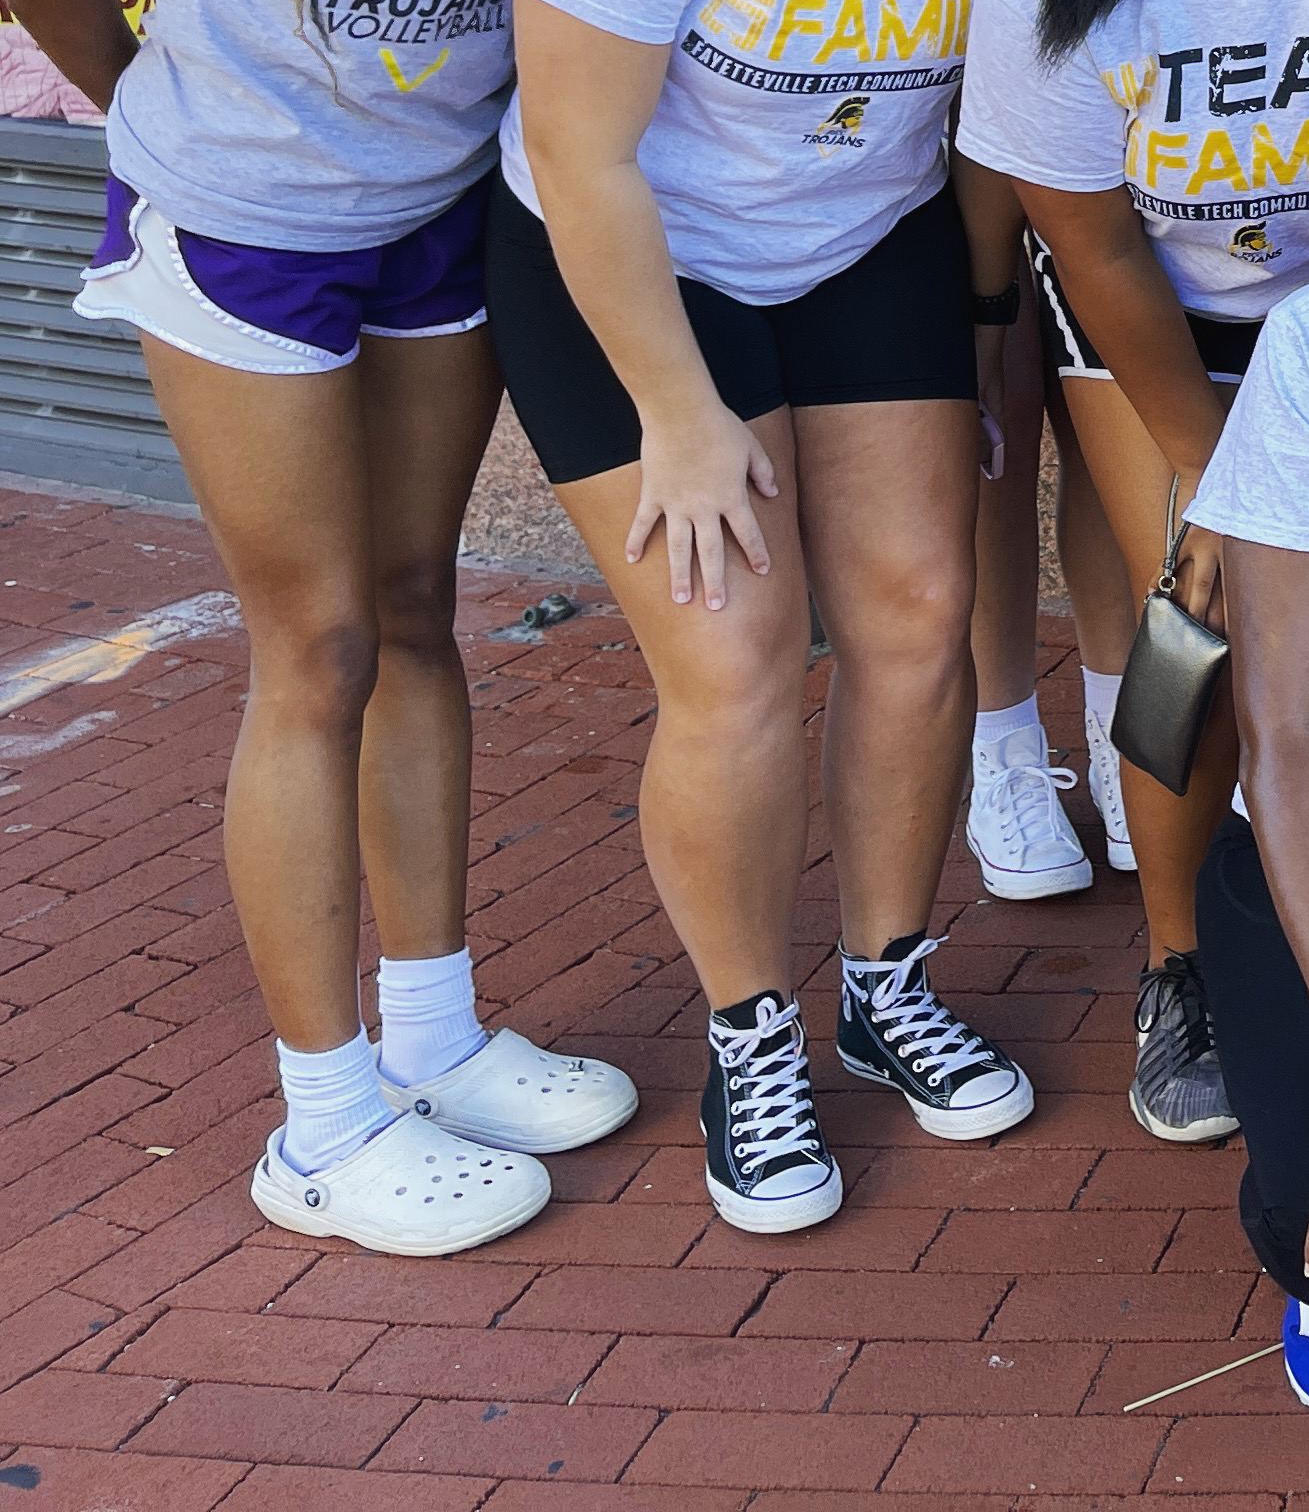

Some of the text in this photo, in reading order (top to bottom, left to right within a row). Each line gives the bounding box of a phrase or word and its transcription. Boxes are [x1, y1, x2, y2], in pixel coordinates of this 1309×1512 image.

[327, 4, 506, 45] VOLLEYBALL
[690, 39, 816, 93] FAYETTEVILLE
[816, 75, 860, 93] TECH
[860, 68, 949, 92] COMMUNITY
[801, 134, 866, 148] TROJANS
[1201, 203, 1244, 220] TECH
